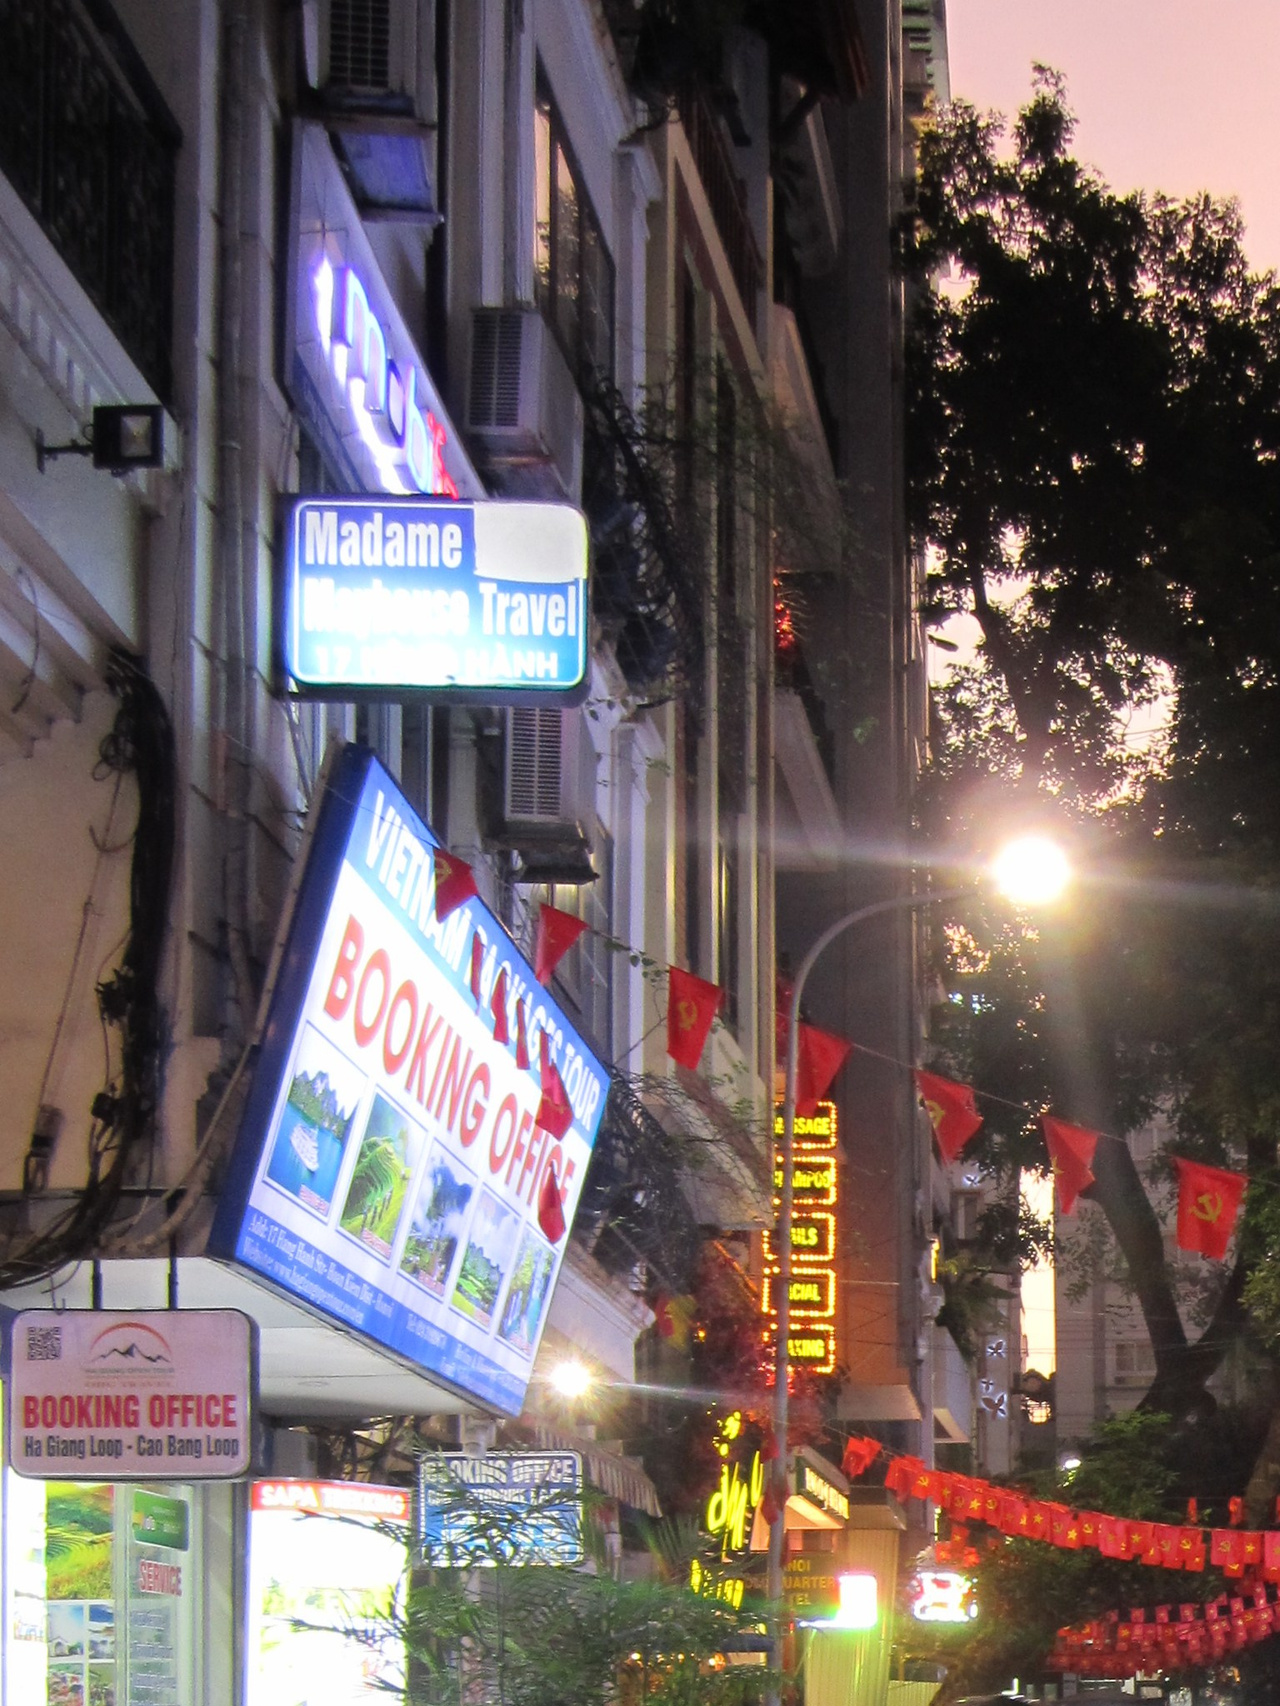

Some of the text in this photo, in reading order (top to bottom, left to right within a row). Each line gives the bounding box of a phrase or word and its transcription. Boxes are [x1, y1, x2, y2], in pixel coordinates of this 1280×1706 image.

[305, 511, 462, 569] Madame
[479, 582, 576, 637] Travel
[324, 913, 491, 1149] BOOKING
[560, 1042, 600, 1132] TOUR
[23, 1394, 238, 1429] BOOKING OFFICE
[24, 1435, 42, 1457] Ha
[47, 1435, 86, 1460] Giang
[90, 1435, 123, 1460] Loop
[137, 1435, 163, 1457] Cao
[167, 1434, 203, 1459] Bang
[206, 1434, 240, 1459] Loop
[259, 1485, 321, 1509] SAPA
